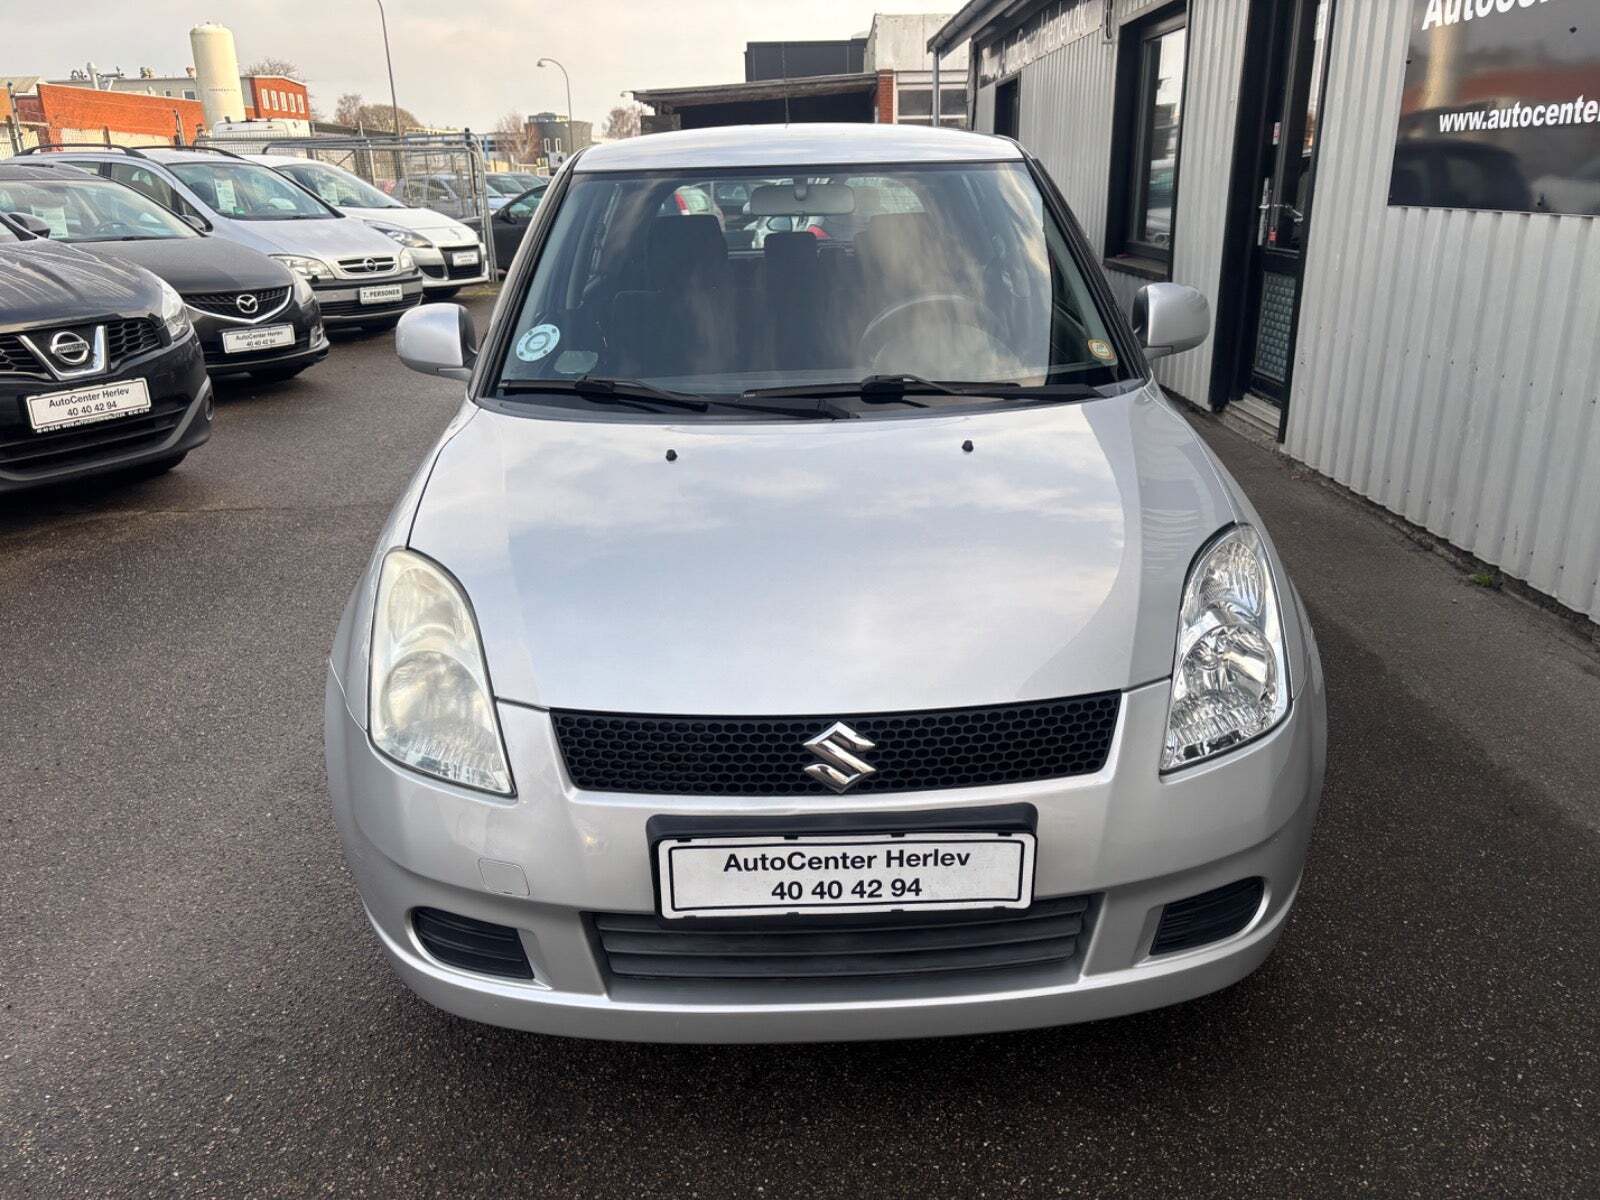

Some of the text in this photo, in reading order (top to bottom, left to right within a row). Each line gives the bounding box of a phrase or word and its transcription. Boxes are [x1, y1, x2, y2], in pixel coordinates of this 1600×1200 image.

[1439, 95, 1600, 132] www.autocente
[49, 387, 130, 408] AutoCenter Herlev
[67, 400, 117, 416] 40 40 42 94
[723, 847, 971, 872] AutoCenter Herlev
[771, 878, 922, 900] 40 40 42 94
